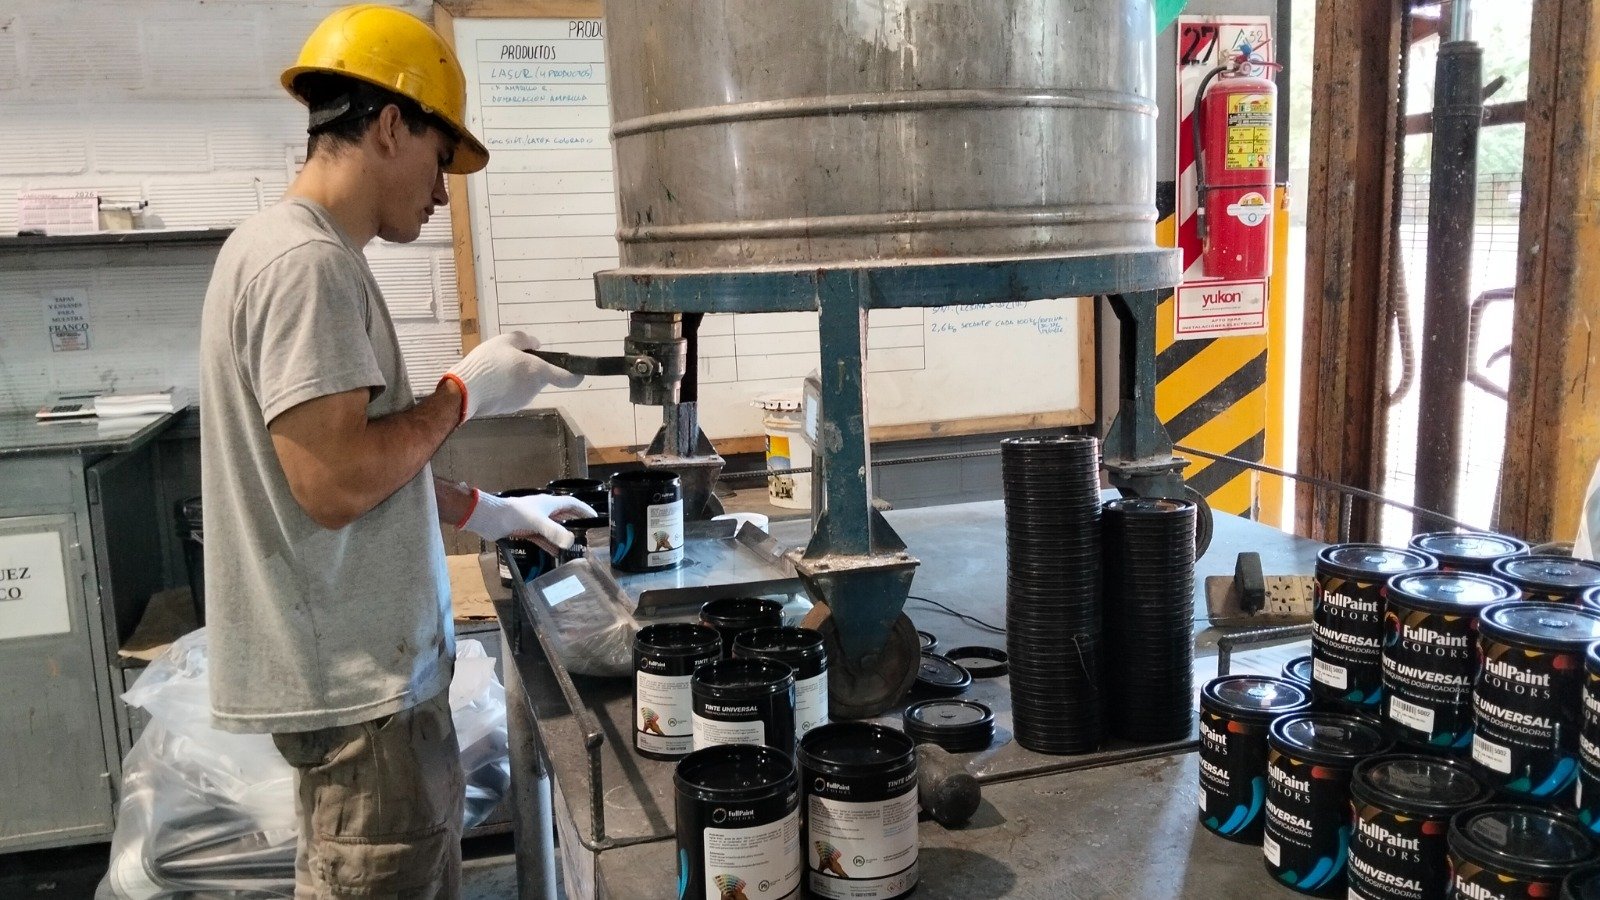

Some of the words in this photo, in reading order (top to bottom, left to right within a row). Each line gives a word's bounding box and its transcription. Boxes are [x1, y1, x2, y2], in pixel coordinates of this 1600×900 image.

[500, 45, 556, 60] PRODUCTOS
[1181, 26, 1219, 65] 27
[491, 68, 533, 79] LASUR
[1202, 290, 1241, 308] yukon
[49, 323, 89, 332] FRANCO
[1323, 590, 1378, 612] FullPaint
[1323, 604, 1379, 622] COLORS
[1319, 624, 1381, 648] UNIVERSAL
[1403, 624, 1468, 648] FullPaint
[1402, 640, 1469, 659] COLORS
[1397, 663, 1471, 686] UNIVERSAL
[1485, 656, 1551, 687] FullPaint
[1484, 673, 1551, 700] COLORS
[1480, 698, 1553, 729] UNIVERSAL
[728, 809, 754, 817] FullPaint
[1359, 817, 1420, 851] FullPaint
[1358, 833, 1421, 863] COLORS
[1354, 856, 1423, 892] UNIVERSAL
